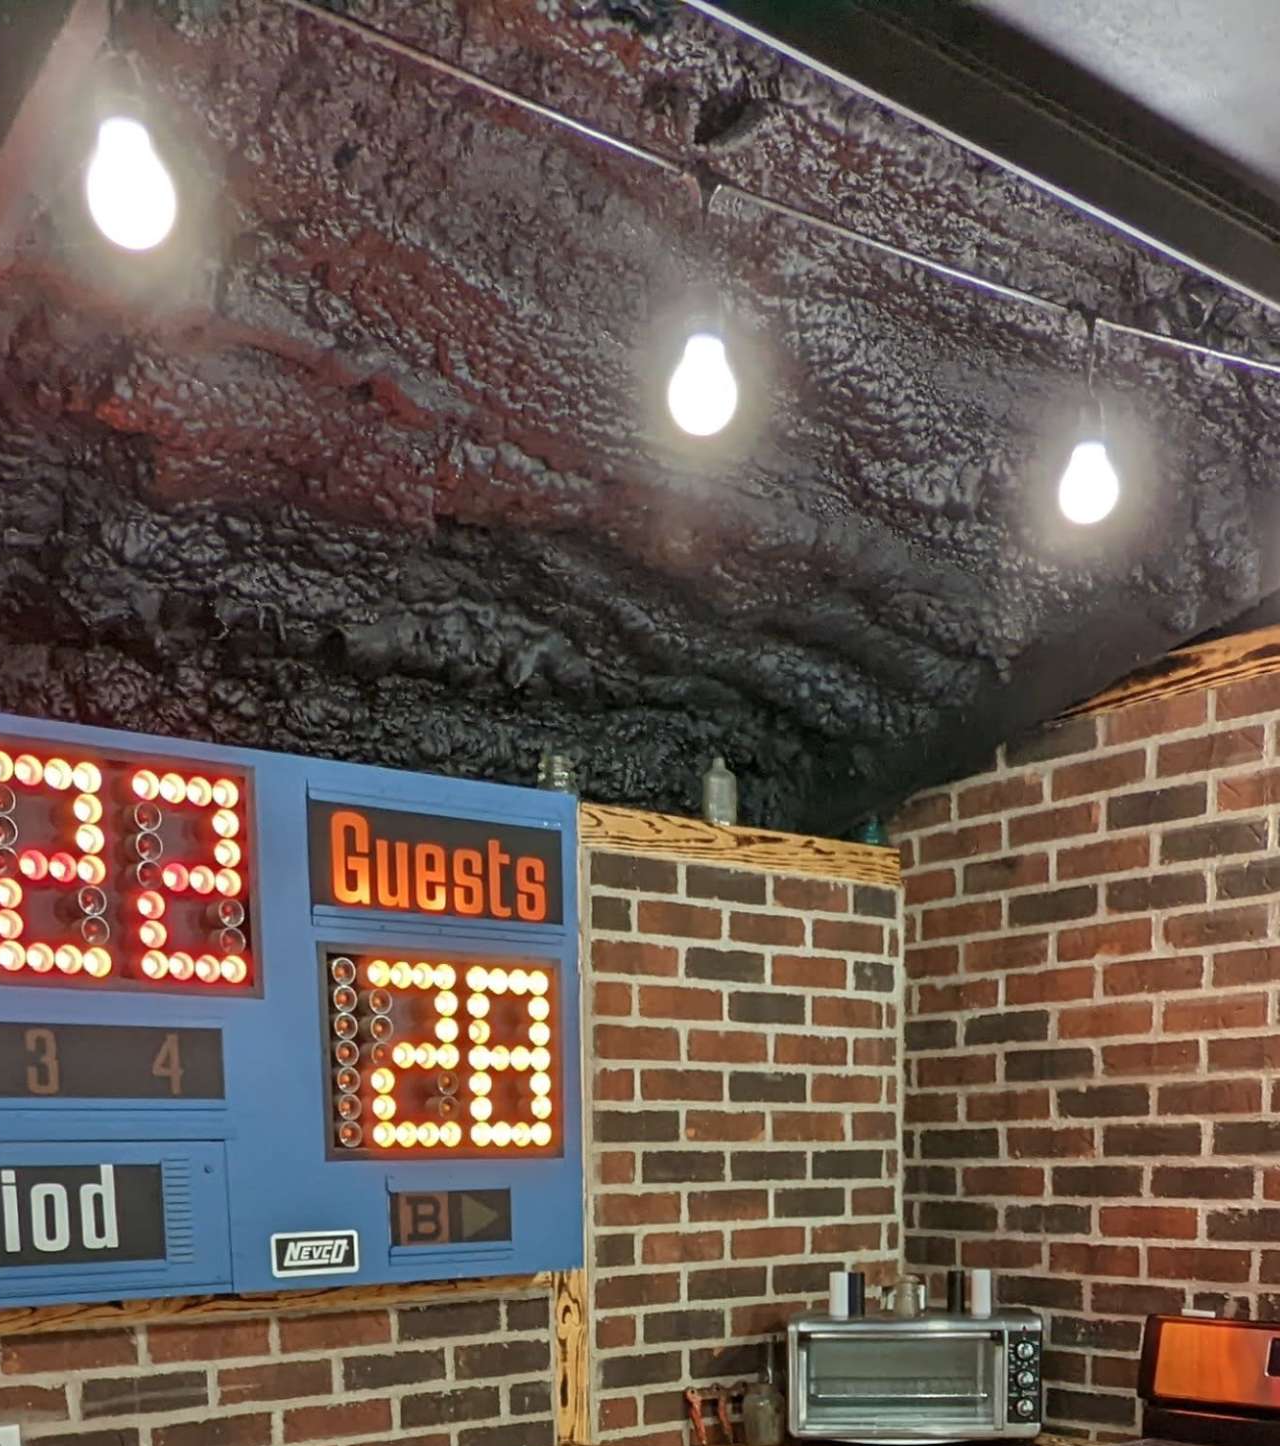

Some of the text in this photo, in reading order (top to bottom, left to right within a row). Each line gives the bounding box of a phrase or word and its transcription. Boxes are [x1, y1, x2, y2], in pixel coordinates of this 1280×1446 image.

[330, 810, 548, 922] Guests
[24, 1028, 60, 1095] 3
[151, 1034, 184, 1095] 4
[406, 1198, 442, 1240] B
[283, 1238, 349, 1267] NEVCO
